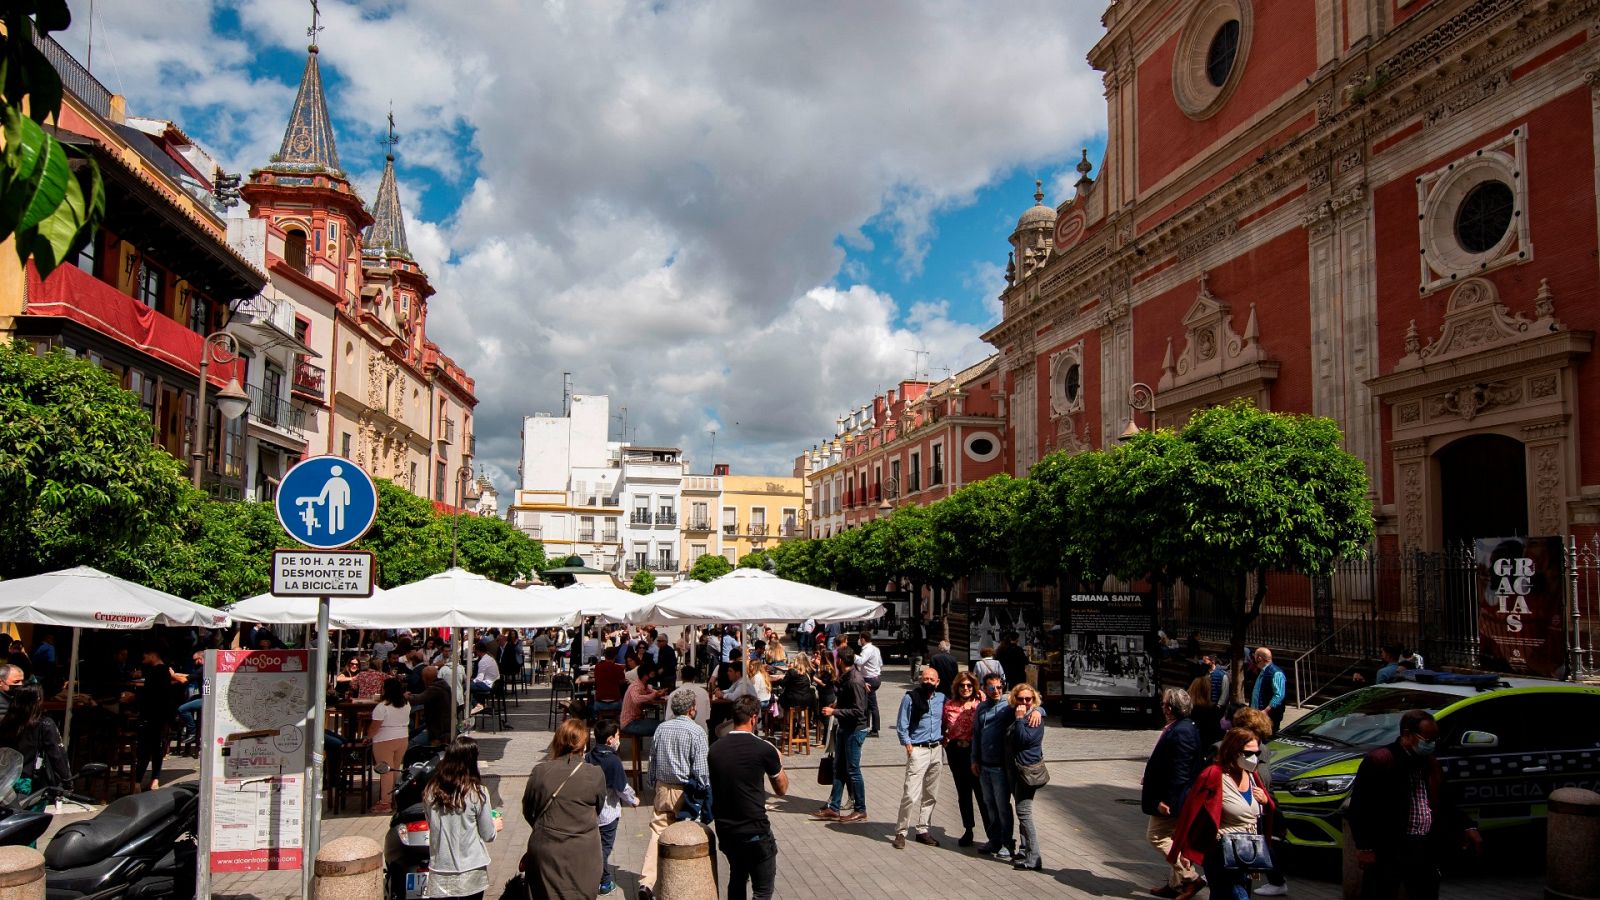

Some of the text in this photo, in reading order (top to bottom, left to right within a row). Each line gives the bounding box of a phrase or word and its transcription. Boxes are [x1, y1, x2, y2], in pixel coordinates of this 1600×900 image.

[281, 557, 364, 566] DE 10 H. A 22 H.
[282, 569, 363, 578] DESMONTE DE
[284, 581, 359, 590] LA BICICLETA
[1071, 594, 1142, 602] SEMANA SANTA
[94, 611, 147, 624] Cruzcampo
